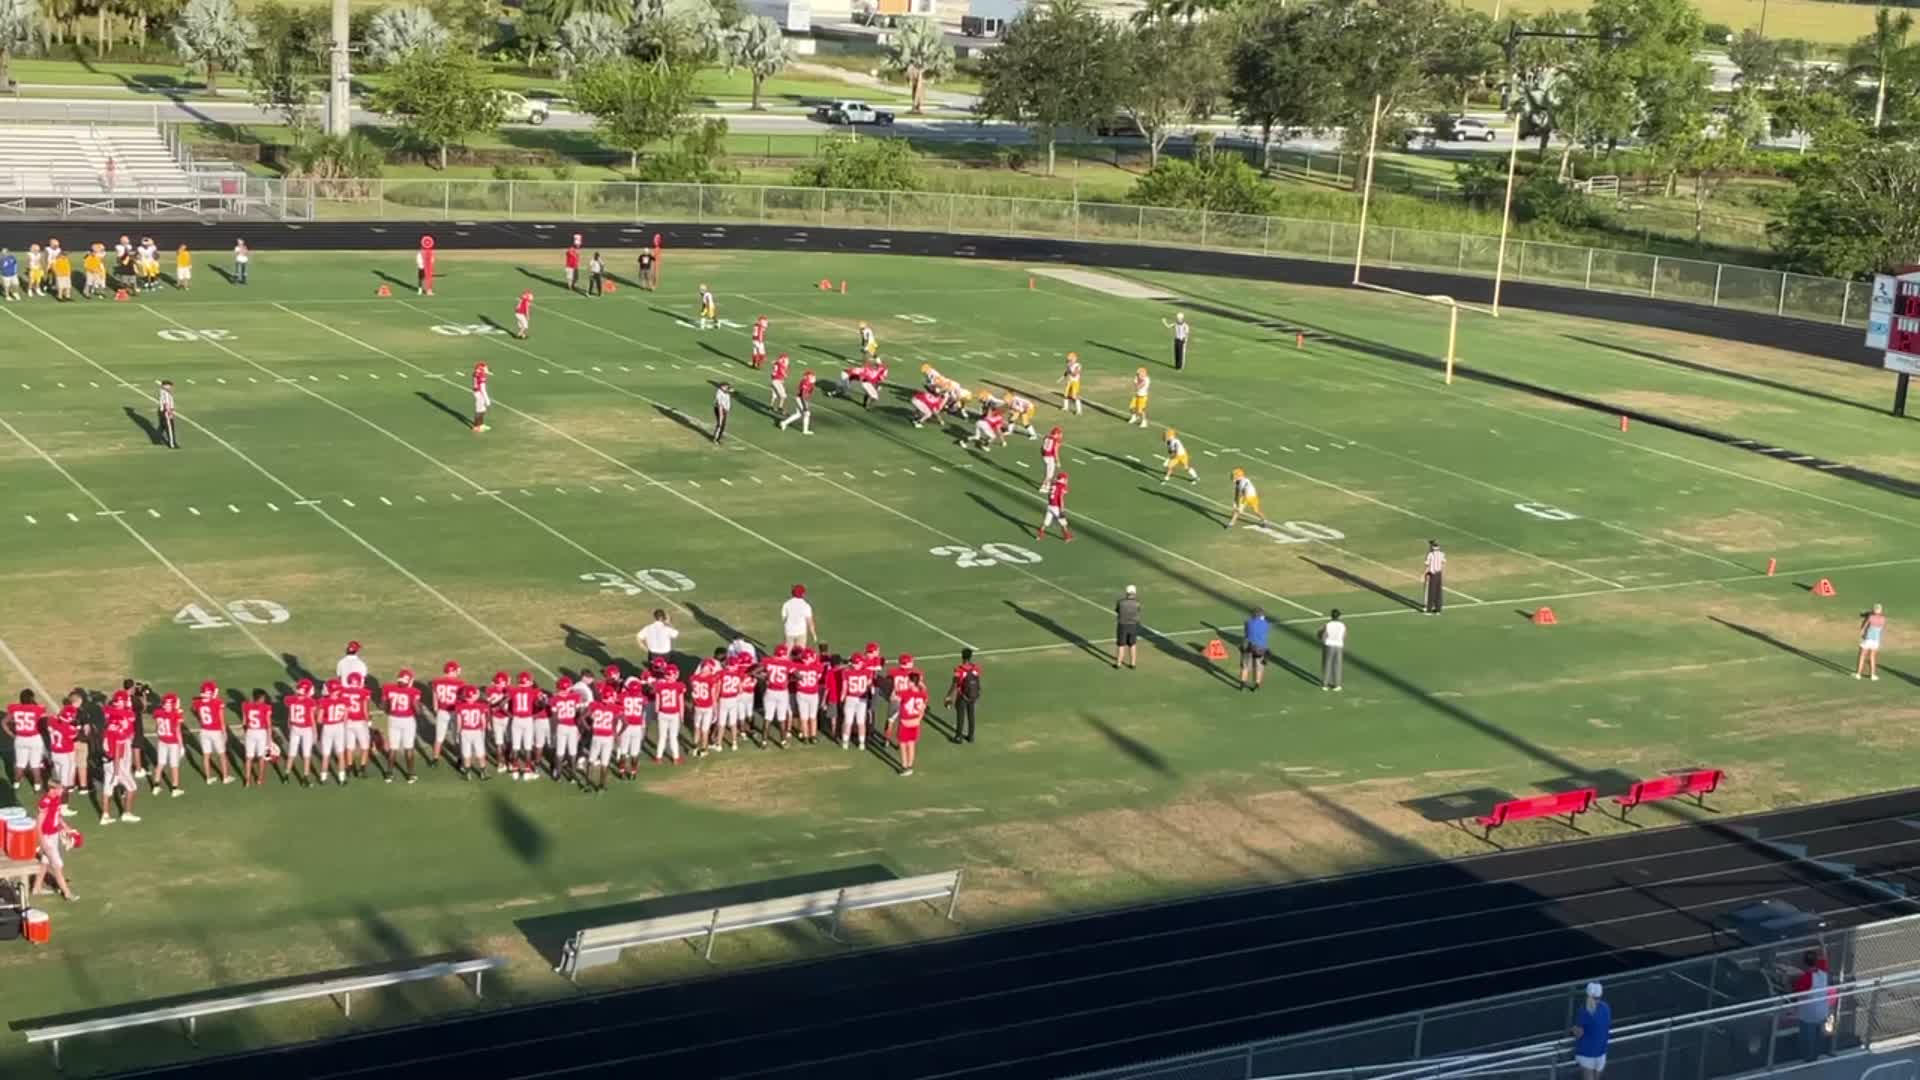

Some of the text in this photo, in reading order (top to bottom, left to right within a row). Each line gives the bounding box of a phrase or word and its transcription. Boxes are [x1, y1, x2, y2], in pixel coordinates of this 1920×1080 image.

[157, 329, 239, 341] 30
[1242, 520, 1345, 544] 10
[929, 542, 1043, 568] 20
[579, 568, 697, 596] 30
[173, 599, 290, 629] 40
[766, 664, 787, 684] 75
[848, 675, 868, 694] 50
[388, 692, 409, 711] 79
[516, 692, 529, 712] 11
[623, 697, 643, 716] 95
[660, 689, 677, 708] 21
[200, 705, 213, 725] 6
[249, 709, 261, 729] 5
[289, 703, 306, 724] 12
[461, 709, 481, 728] 30
[556, 700, 576, 719] 26
[592, 709, 613, 730] 22
[13, 710, 36, 732] 55
